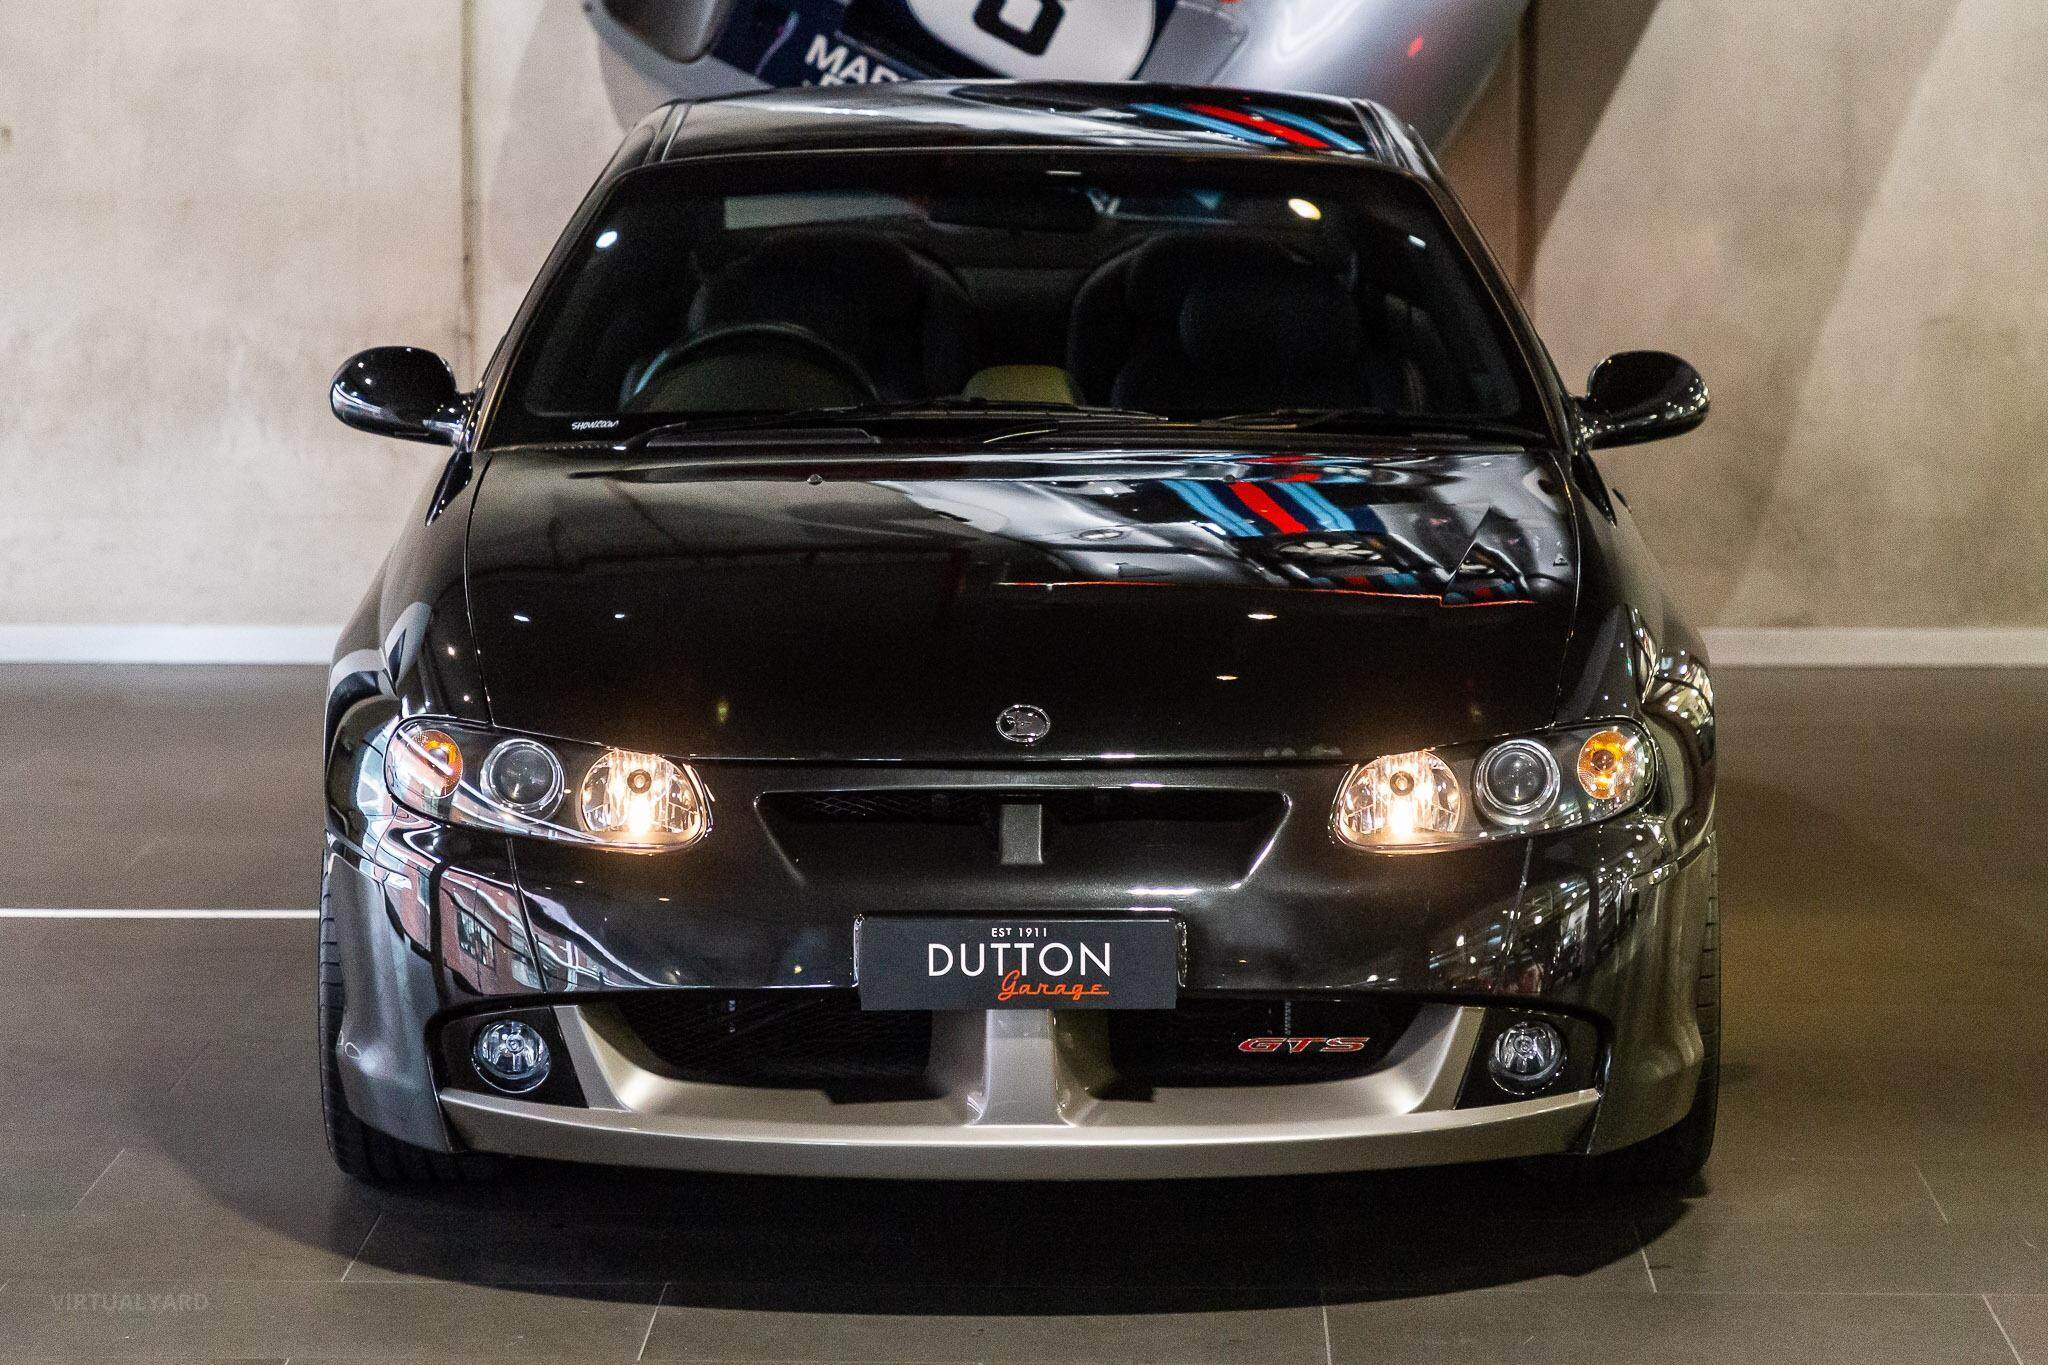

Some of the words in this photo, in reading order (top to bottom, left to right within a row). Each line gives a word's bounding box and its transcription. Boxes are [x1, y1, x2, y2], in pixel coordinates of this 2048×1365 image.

[991, 927, 1012, 938] EST
[1018, 927, 1048, 938] 1911
[927, 942, 1111, 977] DUTTON
[997, 969, 1110, 1001] Garage
[1237, 1036, 1371, 1053] GTS
